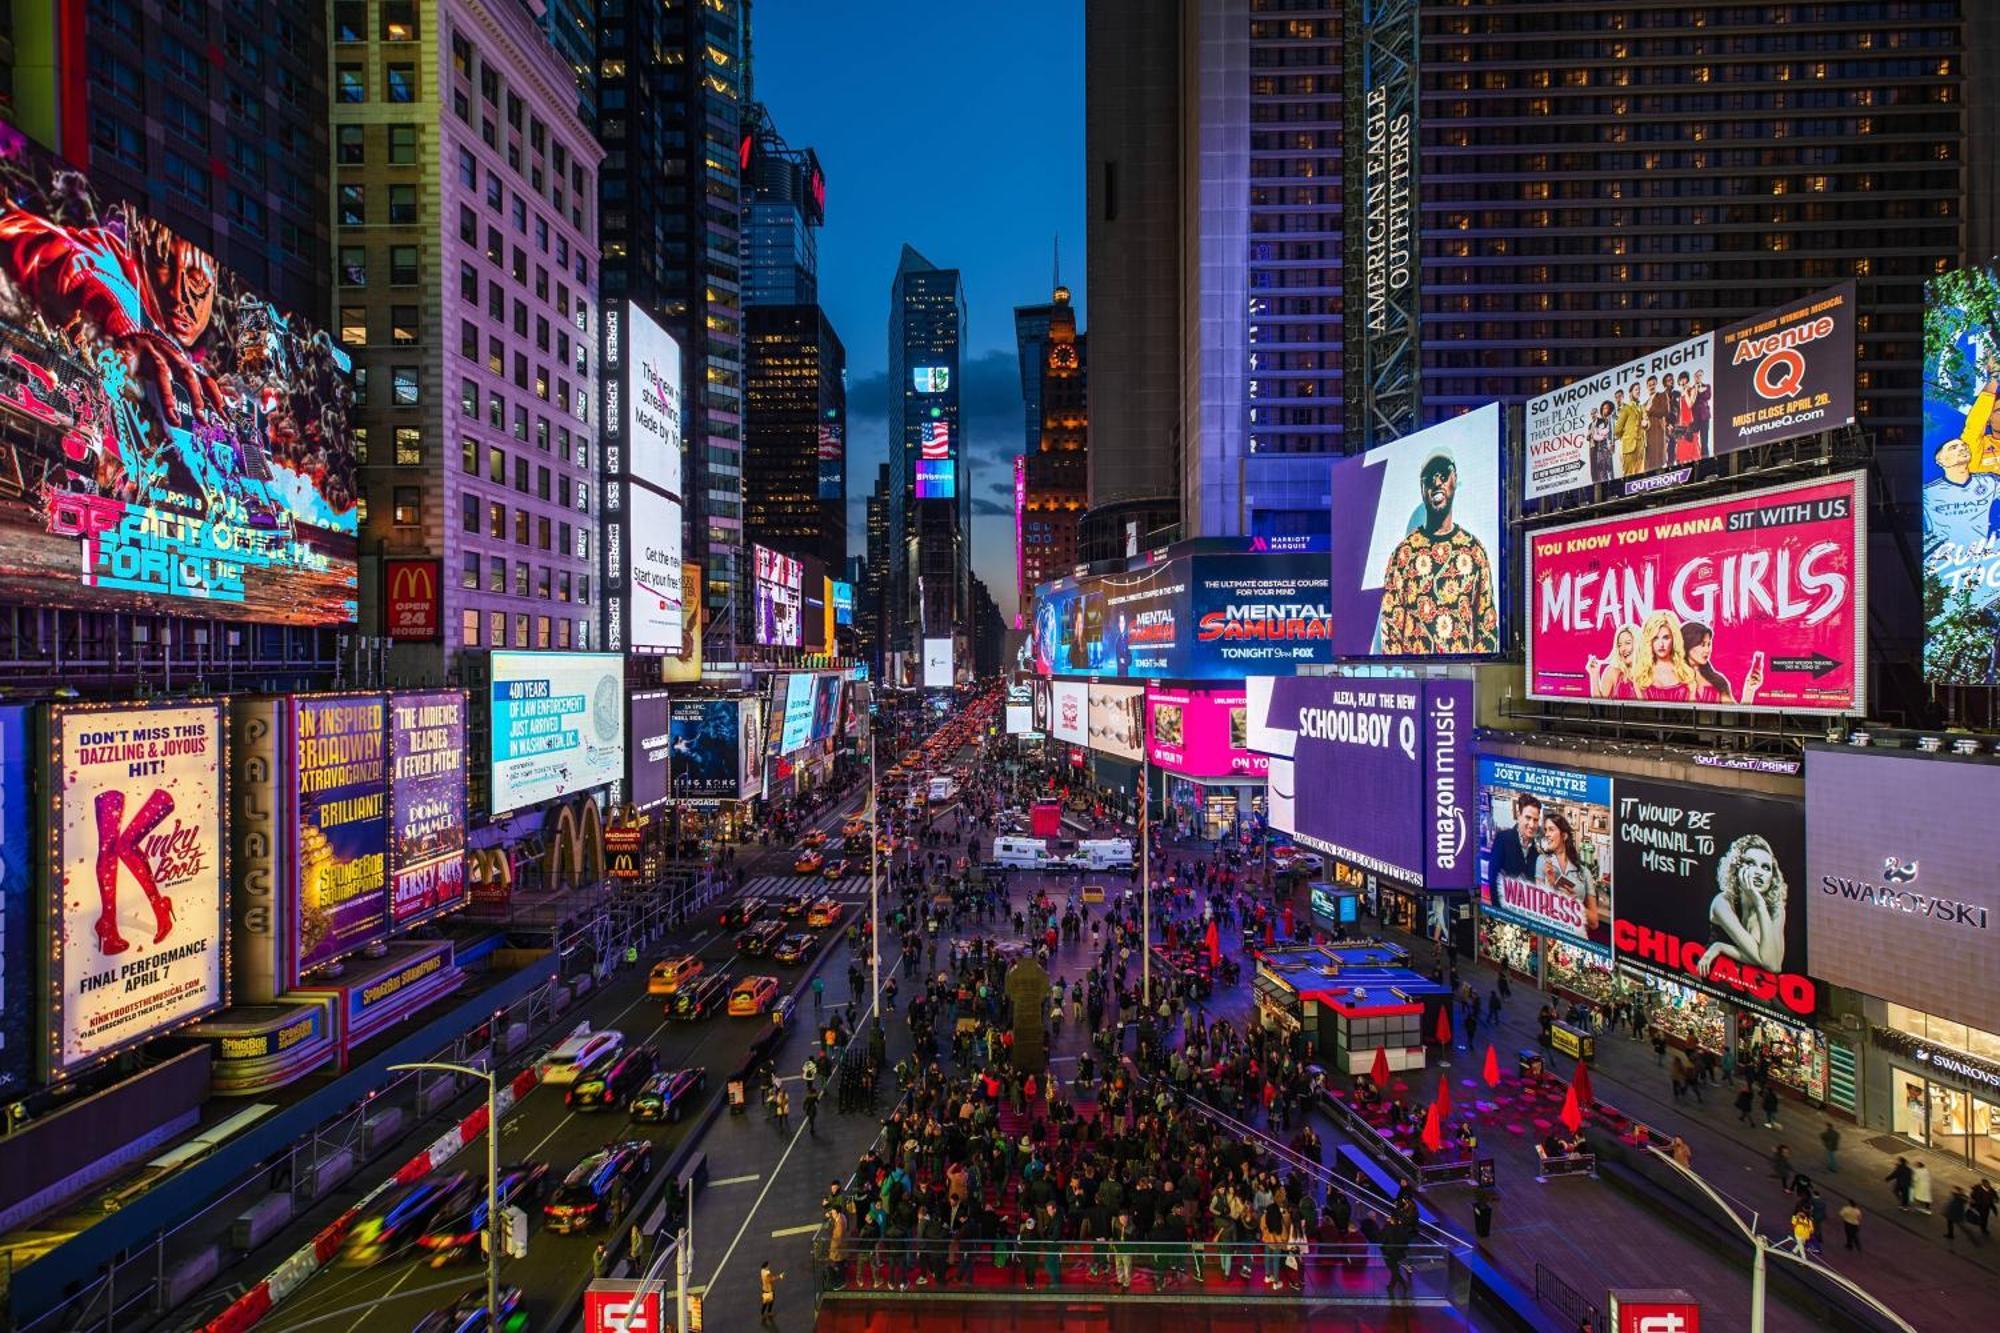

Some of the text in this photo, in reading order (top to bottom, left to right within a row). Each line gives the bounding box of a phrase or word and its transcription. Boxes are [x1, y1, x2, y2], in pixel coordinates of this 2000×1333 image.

[1367, 86, 1386, 331] AMERICAN EAGLE
[1390, 113, 1411, 290] OUTFITTERS
[1780, 308, 1809, 326] WINNING
[1811, 296, 1843, 316] MUSICAL
[1732, 316, 1834, 366] Avenue
[642, 362, 657, 387] The
[1531, 339, 1709, 416] SO WRONG IT'S RIGHT
[1754, 347, 1806, 400] Q
[636, 407, 671, 445] Made by
[1534, 402, 1580, 430] THE PLAY
[1732, 410, 1757, 428] MUST
[1758, 405, 1785, 422] CLOSE
[1786, 398, 1814, 415] APRIL
[1738, 408, 1824, 438] AvenueQ.com
[1530, 414, 1585, 443] THAT GOES
[1530, 433, 1585, 457] WRONG
[1631, 472, 1683, 492] OUTFRONT
[1935, 499, 1989, 513] ETIHAD
[1536, 499, 1848, 560] YOU KNOW YOU WANNA SIT WITH US.
[645, 547, 669, 564] Get the
[633, 566, 651, 585] Start
[652, 573, 666, 588] your
[1220, 580, 1256, 589] ULTIMATE
[1257, 579, 1296, 588] OBSTACLE
[1296, 579, 1329, 588] COURSE
[1541, 541, 1847, 635] MEAN GIRLS
[1236, 589, 1252, 597] FOR
[1276, 588, 1296, 596] MIND
[395, 602, 430, 611] OPEN
[399, 611, 427, 626] 24
[1136, 609, 1176, 625] MENTAL
[1226, 604, 1333, 620] MENTAL
[391, 627, 435, 636] HOURS
[1198, 612, 1333, 641] SAMURAI
[1221, 648, 1315, 659] TONIGHT 9PM FOX
[509, 681, 548, 699] 400 YEARS
[1333, 692, 1416, 710] ALEXA, PLAY THE NEW
[319, 705, 383, 735] INSPIRED
[418, 704, 459, 728] AUDIENCE
[509, 697, 583, 718] OF LAW ENFORCEMENT
[79, 724, 206, 746] DON'T MISS THIS
[510, 716, 560, 737] JUST ARRIVED
[1299, 706, 1416, 760] SCHOOLBOY Q
[147, 742, 158, 759] &
[299, 731, 383, 770] BROADWAY
[410, 728, 449, 753] REACHES
[510, 740, 518, 757] IN
[128, 760, 166, 778] HIT!
[300, 760, 383, 794] XTRAVAGANZA!
[396, 753, 431, 780] A FEVER
[1232, 758, 1250, 769] ON
[1762, 761, 1796, 774] PRIME
[673, 778, 737, 787] KING KONG
[1429, 696, 1457, 869] amazon music
[1494, 768, 1588, 792] JOEY McINTYRE
[320, 793, 384, 829] BRILLIANT!
[409, 800, 450, 823] DONNA
[1621, 798, 1716, 830] IT WOULD BE
[243, 717, 271, 933] PALACE
[404, 813, 456, 840] SUMMER
[1621, 823, 1715, 856] CRIMINAL TO
[154, 853, 210, 886] Boots
[320, 853, 384, 891] SPONGEBOB
[1642, 850, 1699, 877] MISS IT
[396, 865, 437, 902] JERSEY
[1503, 876, 1583, 928] WAITRESS
[1822, 875, 1989, 929] SWAROVSKI
[79, 938, 209, 995] FINAL PERFORMANCE
[125, 965, 171, 994] APRIL 7
[1613, 918, 1816, 1016] CHICAGO
[363, 978, 401, 1006] SPONGEBOB
[1728, 975, 1758, 991] MUSICAL
[89, 978, 200, 1028] KINKYBOOTSTHEMUSICAL.COM
[87, 1029, 97, 1038] AL
[97, 1013, 137, 1034] HIRSCHFELD
[222, 1036, 268, 1050] SPONGEBOB
